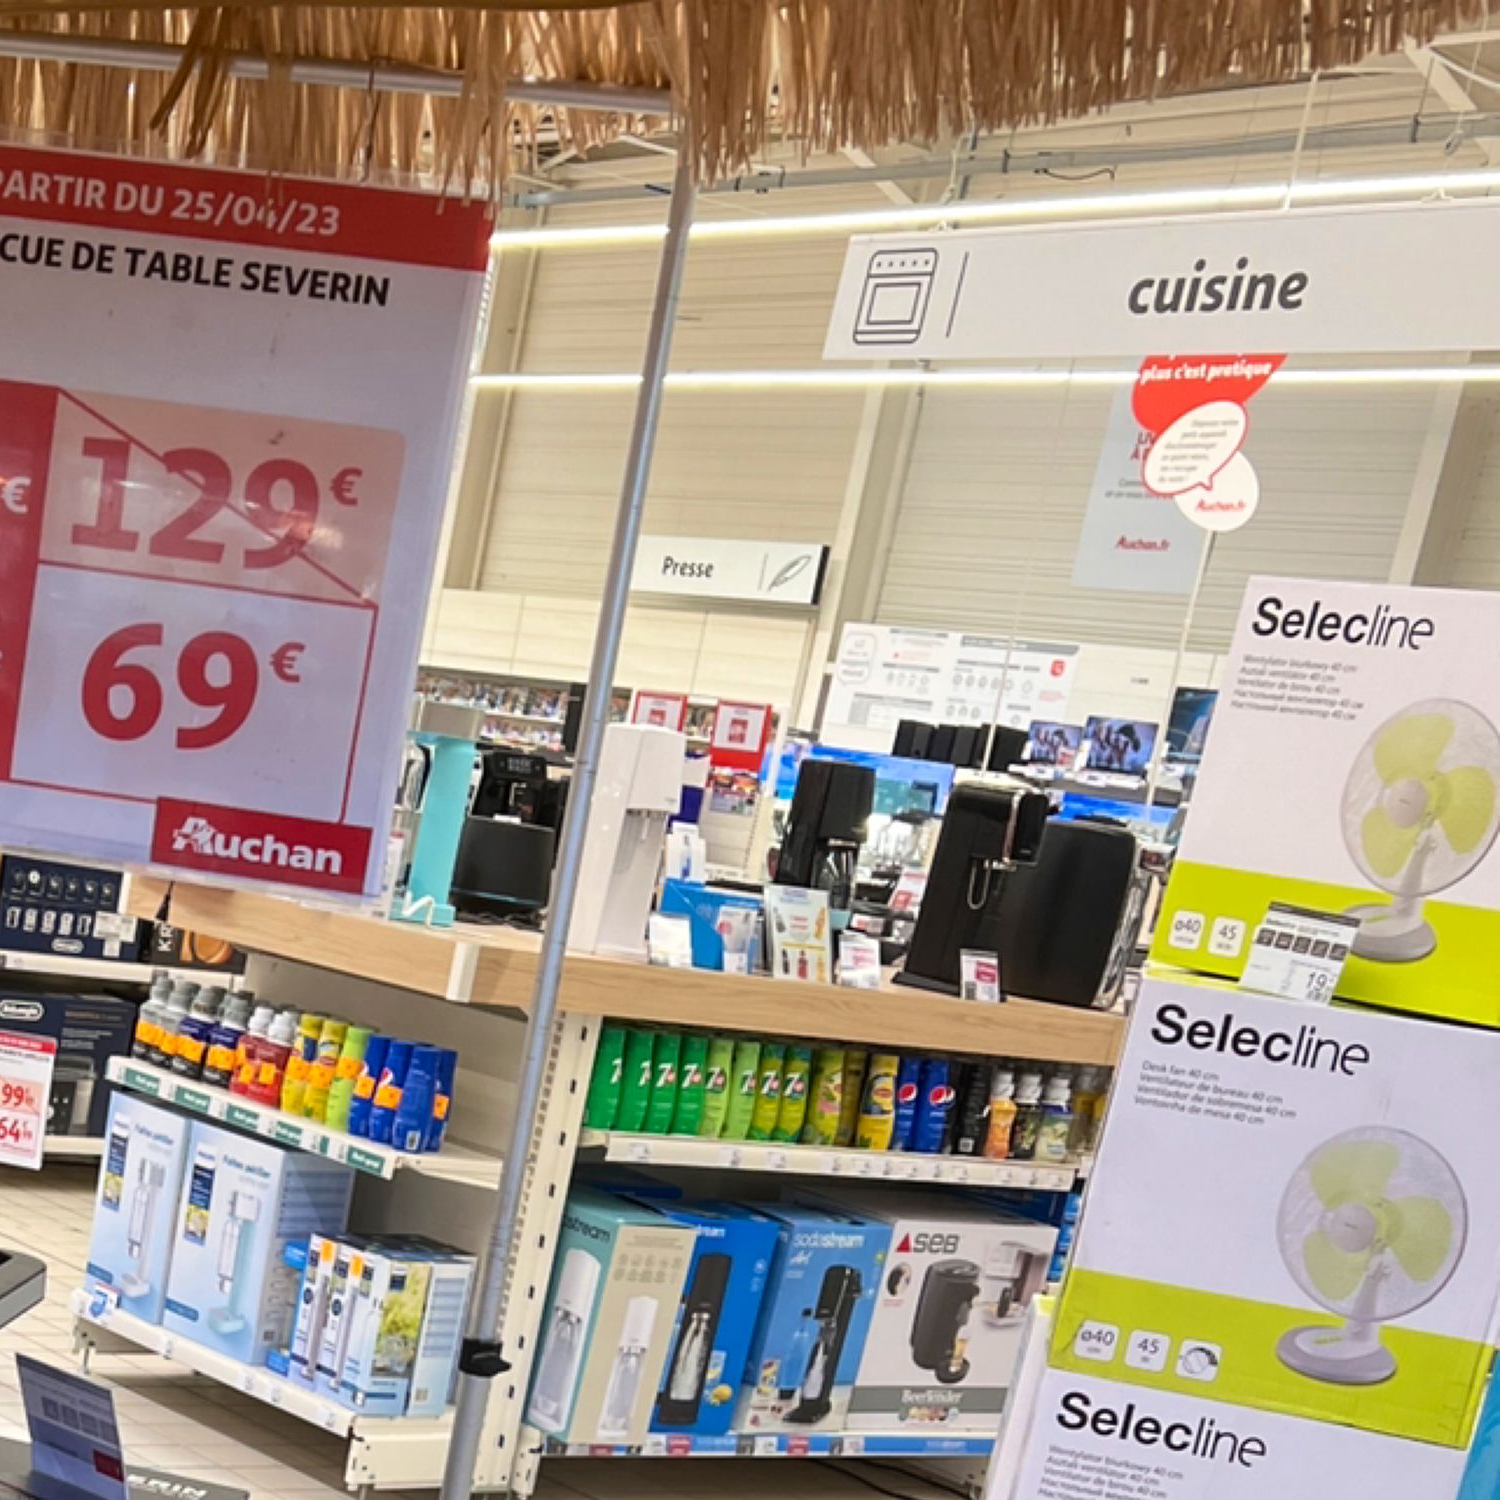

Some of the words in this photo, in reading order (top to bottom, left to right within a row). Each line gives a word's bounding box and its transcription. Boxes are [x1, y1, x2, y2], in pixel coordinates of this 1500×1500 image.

[113, 181, 164, 216] DU
[170, 188, 340, 236] 25/04/23
[71, 240, 114, 274] DE
[124, 247, 234, 290] TABLE
[240, 260, 390, 307] SEVERIN
[1127, 256, 1309, 315] cuisine
[1140, 365, 1171, 386] plus
[1207, 359, 1272, 381] pratique
[661, 554, 714, 582] Presse
[1251, 596, 1436, 650] Selecline
[172, 814, 343, 875] Auchan
[1219, 923, 1238, 941] 45
[1150, 1003, 1370, 1076] Selecline
[1142, 1059, 1167, 1074] Desk
[1188, 1068, 1201, 1080] 40
[1202, 1072, 1220, 1082] cm
[1137, 1084, 1189, 1102] Ventilador
[1191, 1091, 1204, 1104] de
[1207, 1095, 1263, 1115] sobremesa
[1264, 1103, 1278, 1117] 40
[1280, 1108, 1297, 1119] cm
[1139, 1071, 1197, 1092] Ventilateur
[1199, 1079, 1211, 1093] de
[1212, 1083, 1249, 1100] bureau
[1251, 1089, 1265, 1102] 40
[1266, 1095, 1284, 1105] cm
[1204, 1107, 1232, 1120] mesa
[1233, 1110, 1245, 1123] 40
[1247, 1115, 1264, 1126] cm
[793, 1232, 865, 1249] sodastream
[1137, 1337, 1160, 1356] 45
[1056, 1390, 1268, 1468] Selecline
